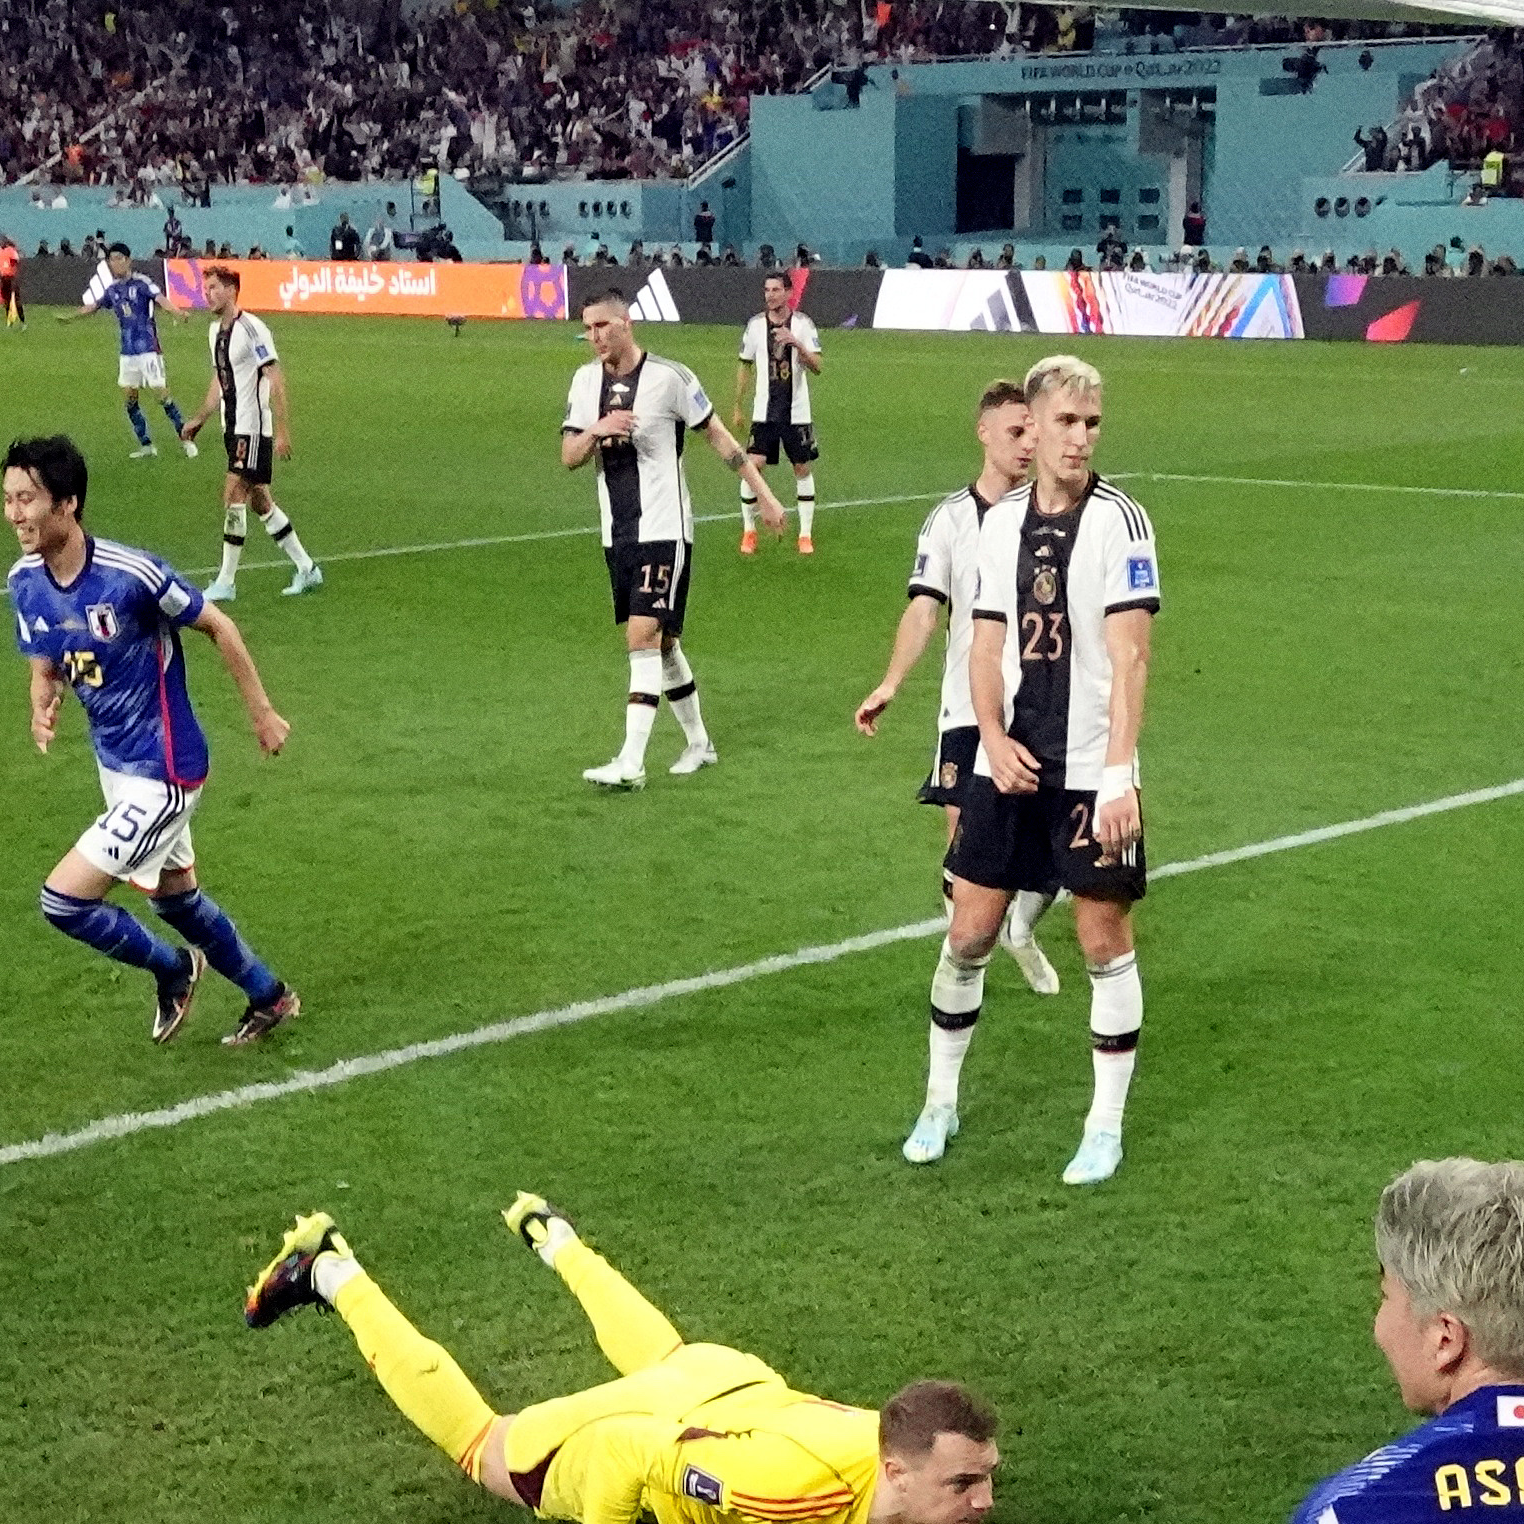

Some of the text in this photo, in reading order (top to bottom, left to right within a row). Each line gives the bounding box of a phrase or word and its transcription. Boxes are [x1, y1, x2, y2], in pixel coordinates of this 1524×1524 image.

[279, 266, 331, 309] الدولي
[335, 263, 384, 301] خليفة
[638, 563, 671, 595] 15
[1021, 611, 1065, 662] 23
[63, 650, 104, 688] 15
[98, 799, 147, 842] 15
[1068, 802, 1090, 849] 2
